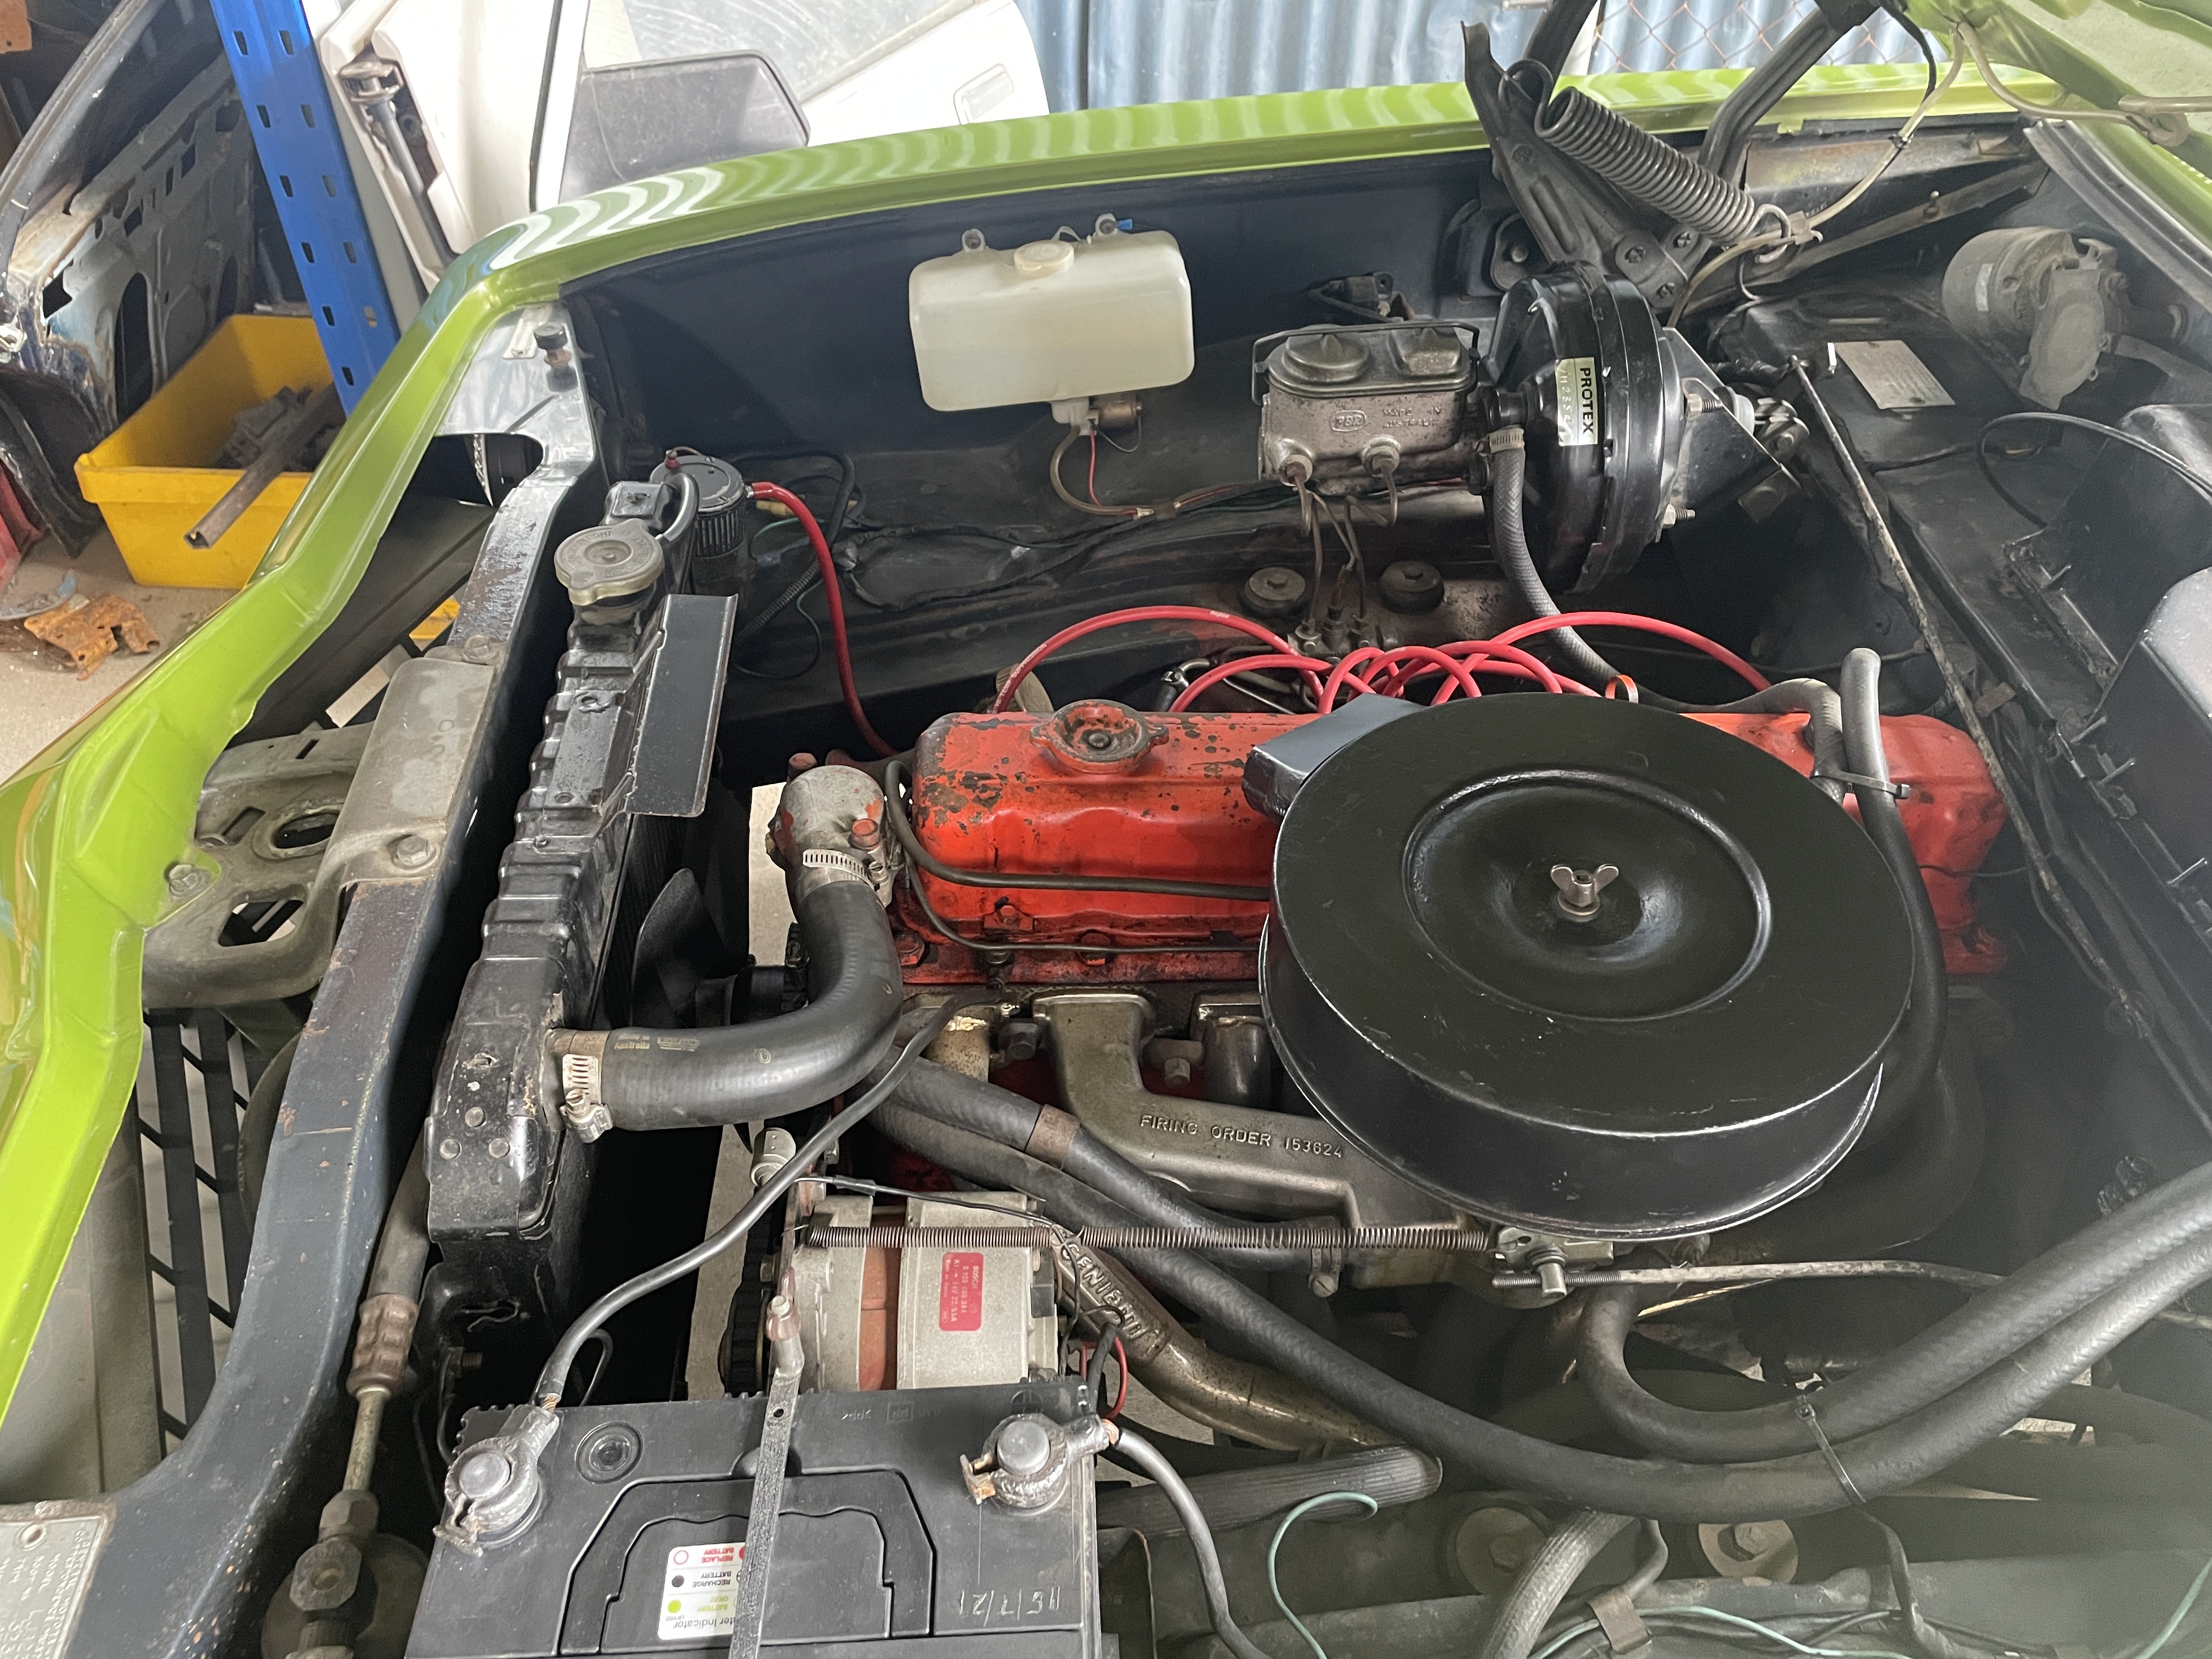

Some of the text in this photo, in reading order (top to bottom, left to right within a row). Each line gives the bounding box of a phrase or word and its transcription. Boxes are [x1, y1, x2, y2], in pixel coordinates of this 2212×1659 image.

[1580, 367, 1594, 435] PROTEX
[1383, 408, 1412, 417] MADE
[1000, 679, 1012, 697] TEMP
[614, 1041, 650, 1050] Australia
[1140, 1115, 1343, 1158] FIRING ORDER 153624
[692, 1579, 731, 1587] RECHARGE
[674, 1618, 716, 1629] Indicator
